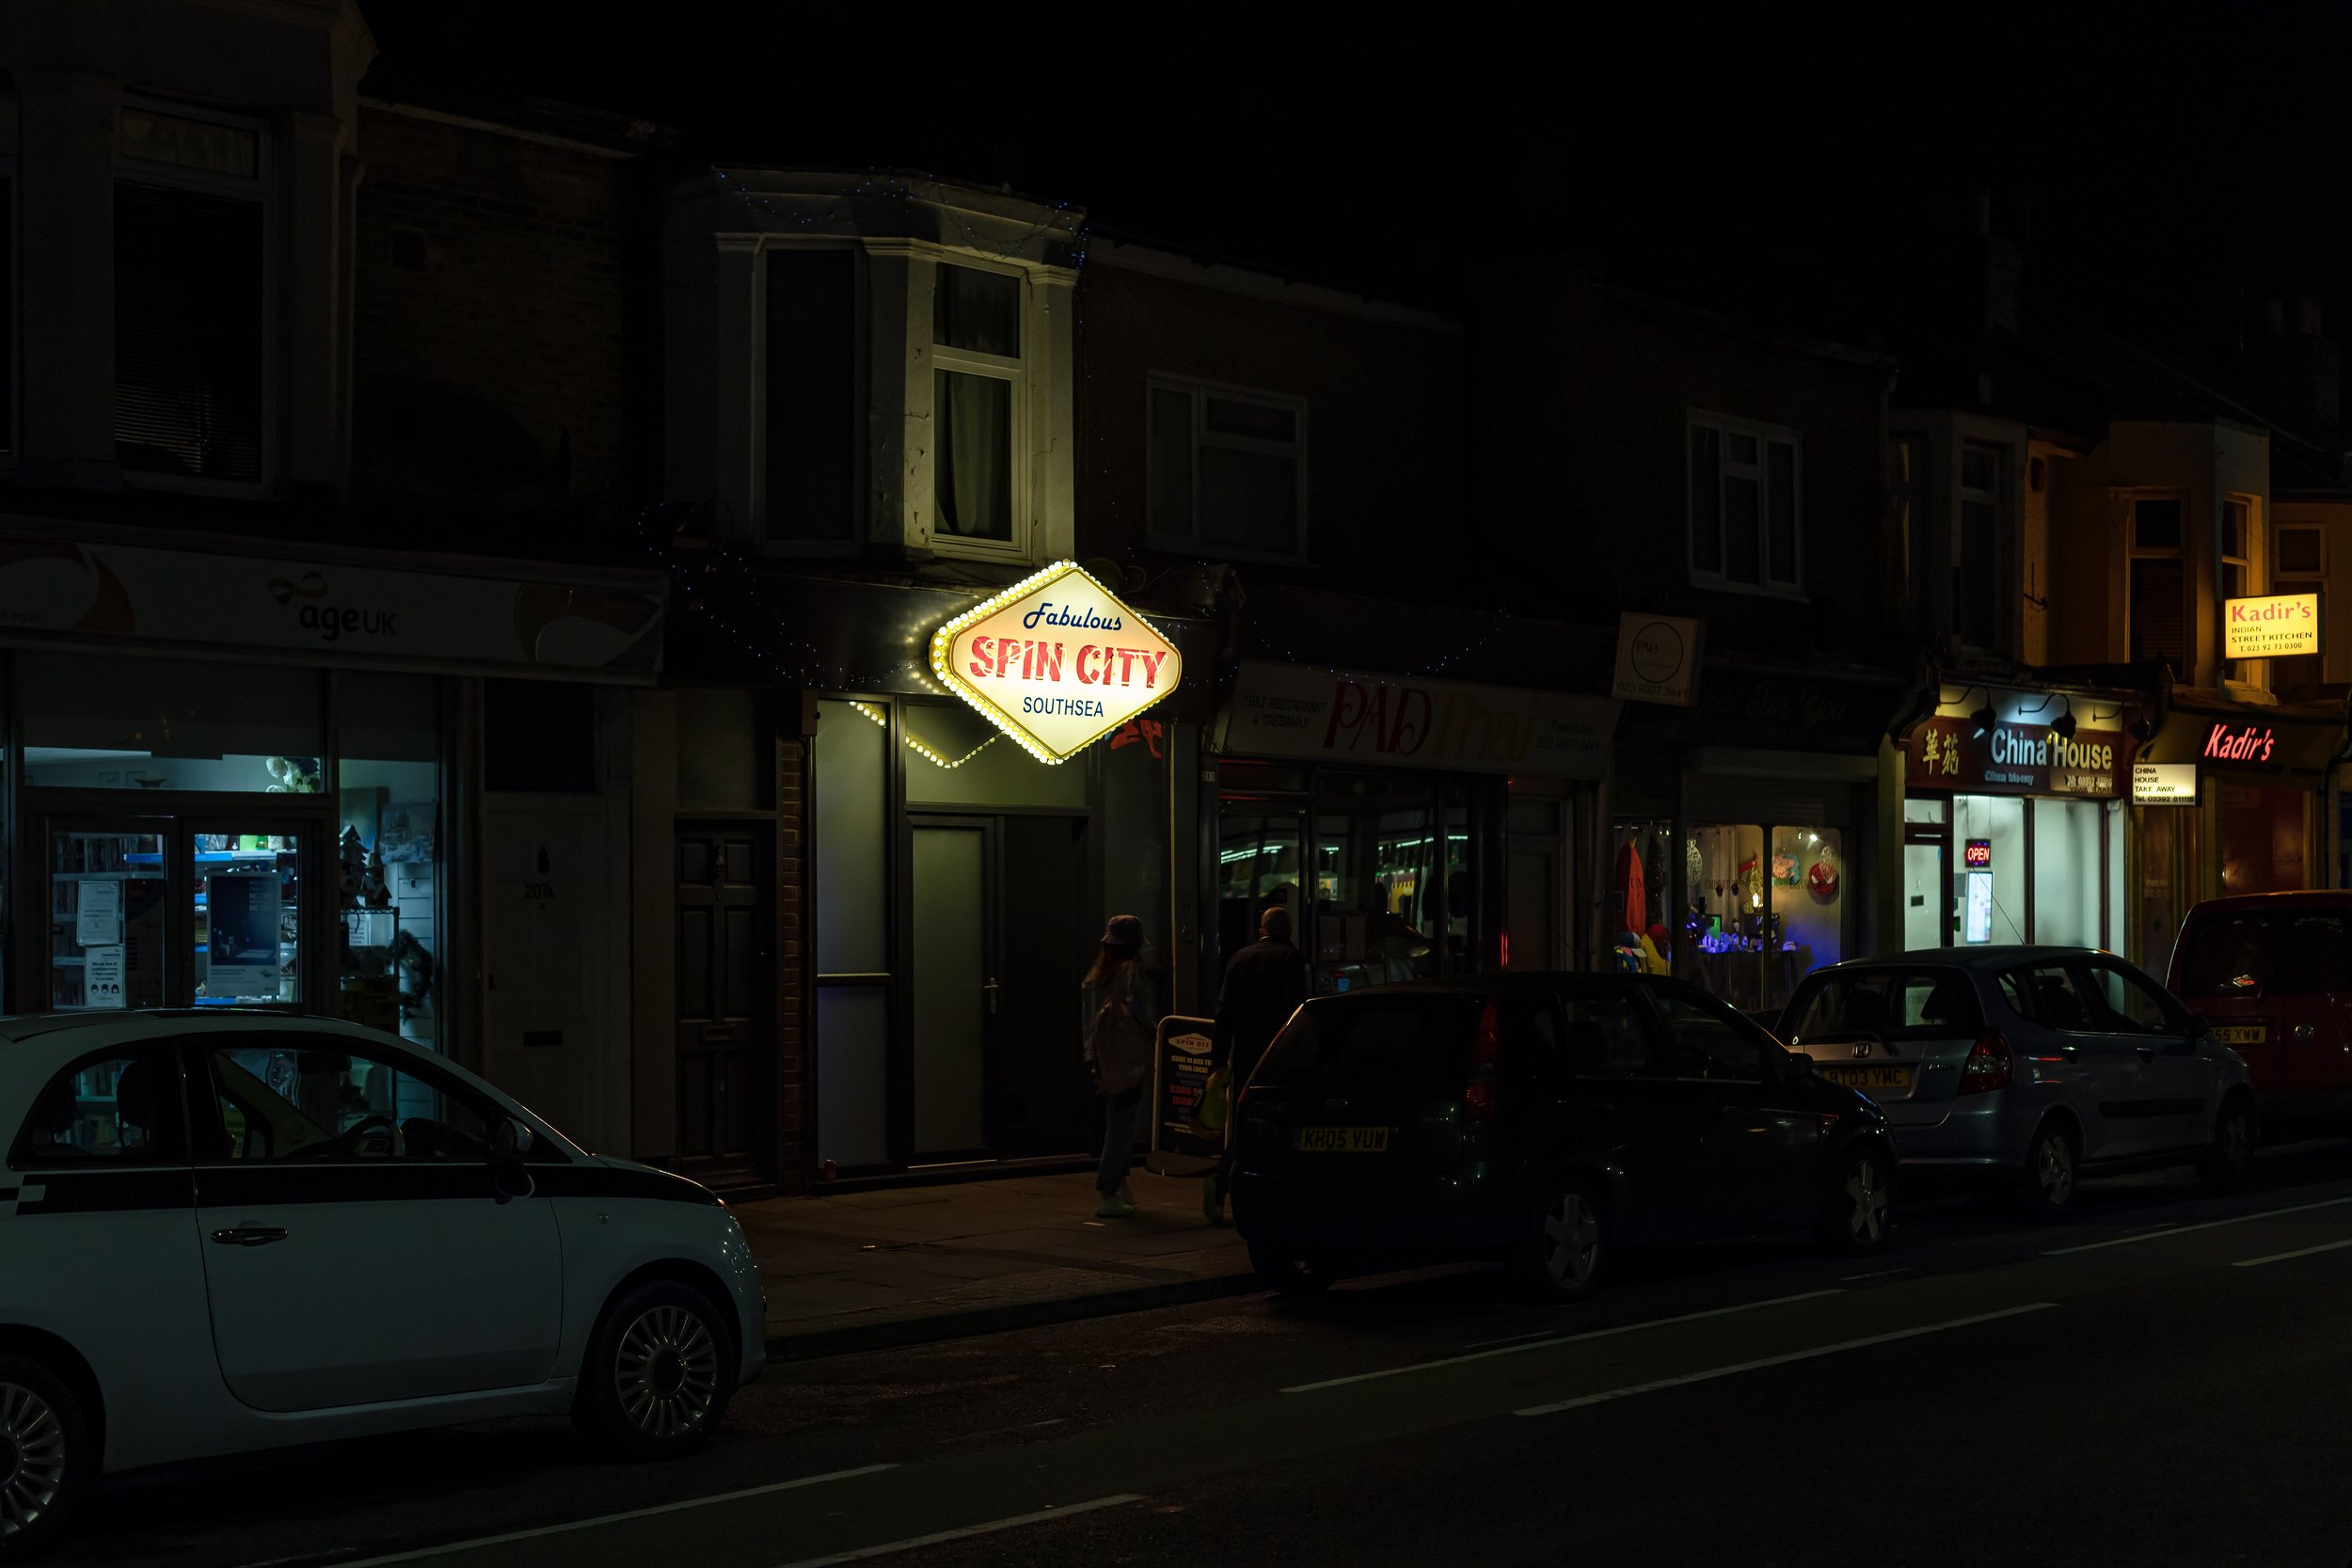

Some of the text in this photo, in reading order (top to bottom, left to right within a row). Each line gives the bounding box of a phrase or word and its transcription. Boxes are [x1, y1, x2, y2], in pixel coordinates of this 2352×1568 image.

[1023, 603, 1121, 631] Fabulous
[2232, 602, 2311, 622] Kadir's
[299, 606, 397, 641] age UK
[2232, 632, 2312, 642] STREET KITCHEN
[970, 636, 1168, 688] SPIN CITY
[1618, 680, 1635, 692] 023
[1023, 697, 1104, 718] SOUTHSEA
[1242, 694, 1327, 714] THAI RESTAURANT
[1263, 714, 1309, 729] TAKEAWAY
[1323, 682, 1540, 763] PAD Thai
[1551, 720, 1597, 736] Telephone
[1991, 728, 2112, 769] China House
[2204, 723, 2275, 761] Kadir's
[1967, 847, 1990, 861] OPEN
[525, 882, 555, 900] 207A
[1873, 1069, 1903, 1085] YMC
[1304, 1130, 1347, 1148] KH05
